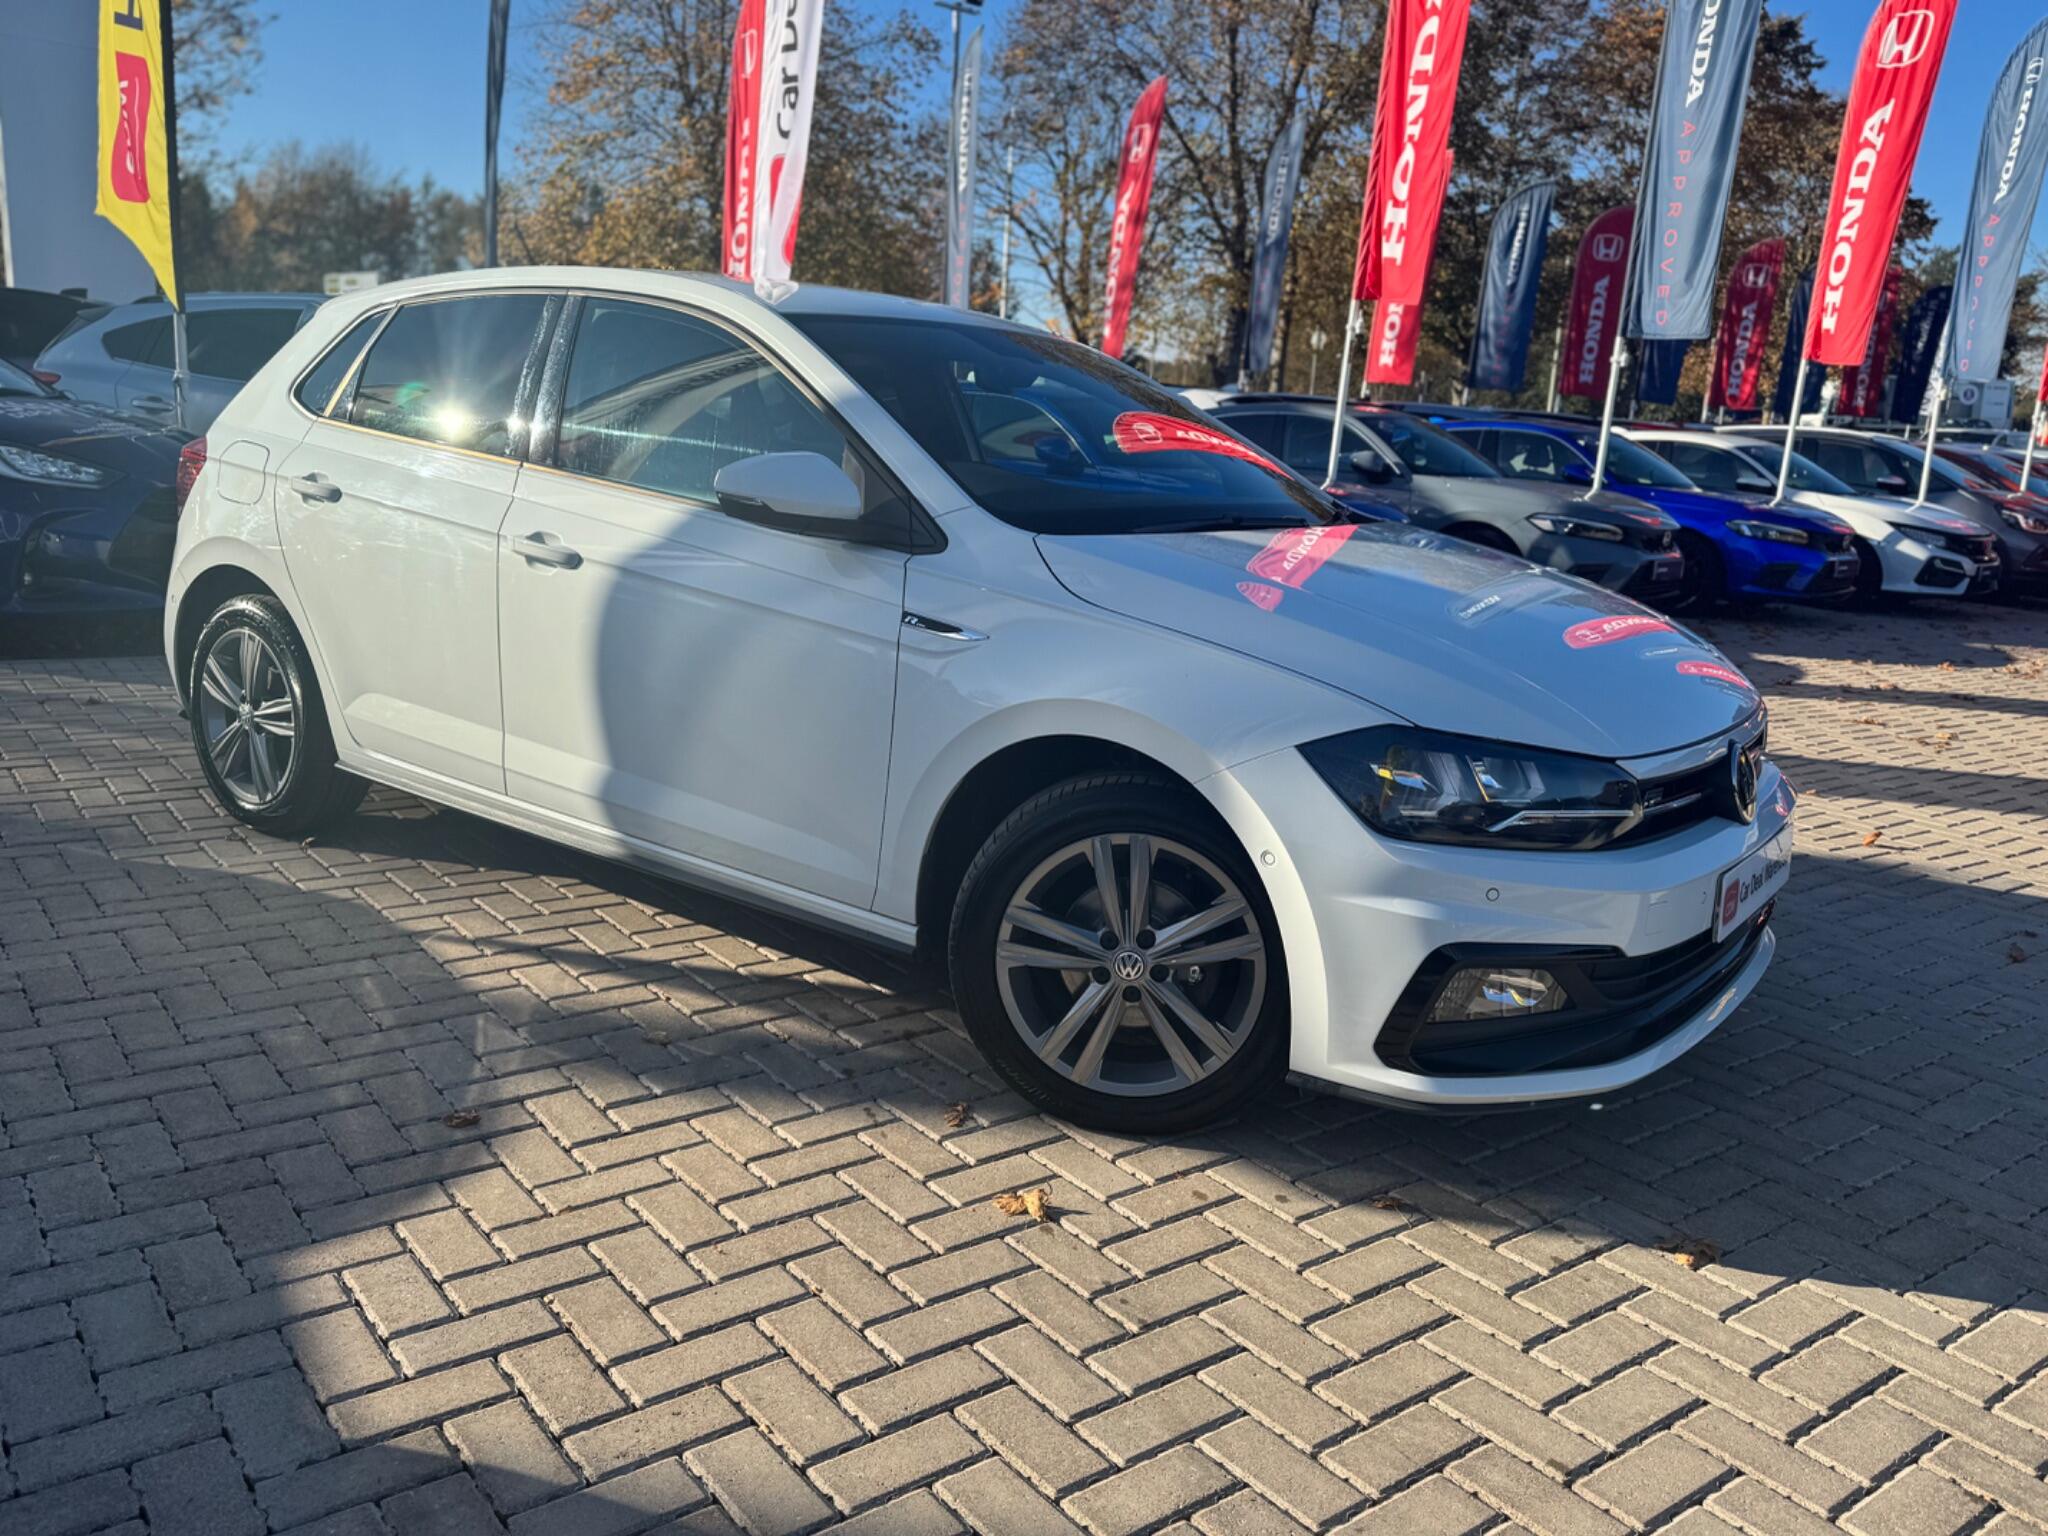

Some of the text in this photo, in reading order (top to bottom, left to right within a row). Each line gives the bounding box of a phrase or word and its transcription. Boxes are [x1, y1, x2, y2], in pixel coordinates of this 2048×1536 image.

[777, 66, 799, 140] Car
[1382, 0, 1443, 266] HOND
[1993, 87, 2032, 204] HONDA
[1655, 120, 1697, 328] APPROVED
[1821, 98, 1895, 335] HONDA
[1578, 274, 1611, 385] HONDA
[1727, 301, 1758, 397] HONDA
